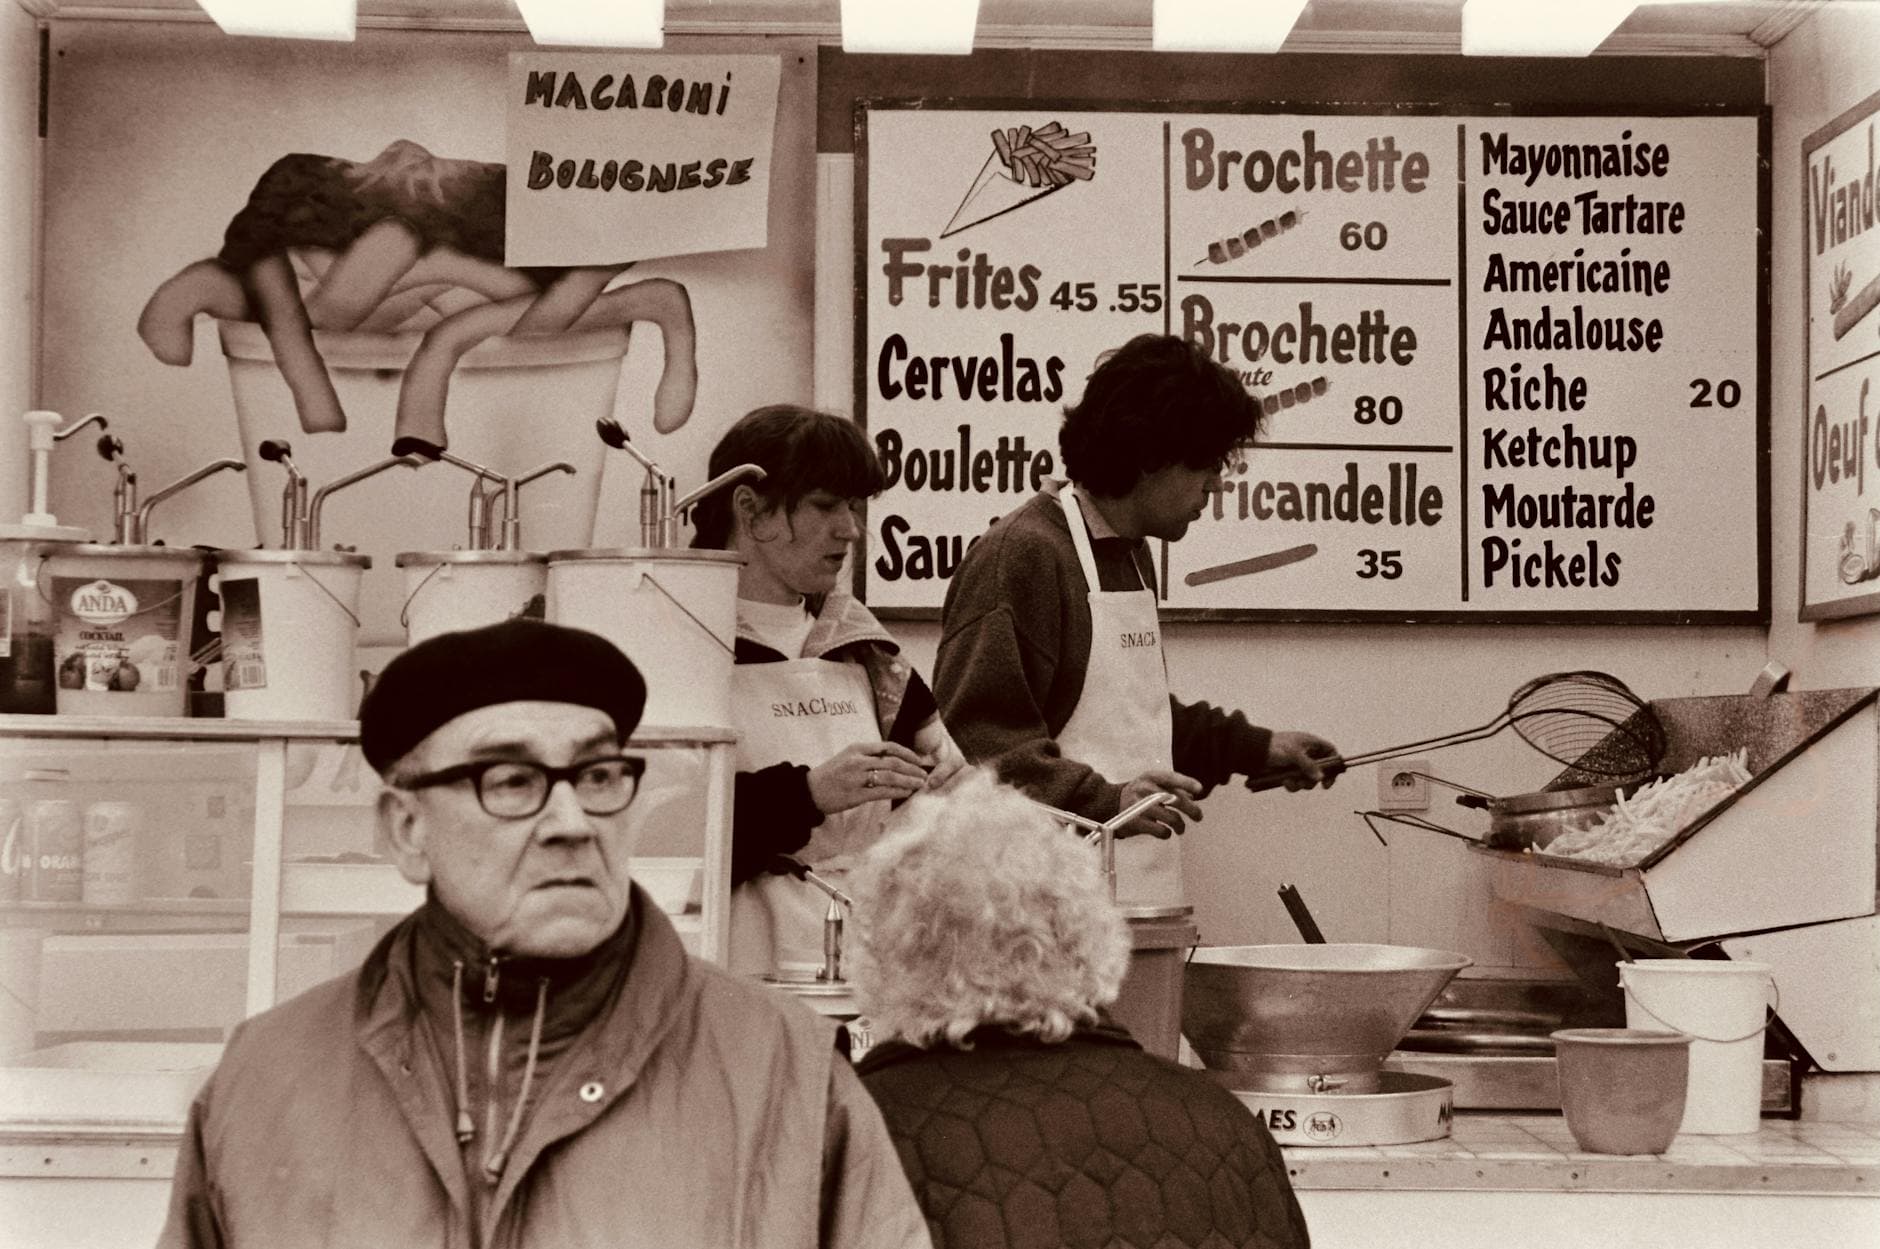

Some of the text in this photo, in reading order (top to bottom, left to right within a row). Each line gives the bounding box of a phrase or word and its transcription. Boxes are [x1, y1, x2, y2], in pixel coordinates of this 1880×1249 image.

[527, 150, 754, 193] BOLOGNESE
[1181, 127, 1430, 194] Brochette
[1480, 130, 1669, 187] Mayonnaise
[1339, 221, 1388, 251] 60
[1483, 188, 1686, 235] Sauce Tartare
[881, 237, 1042, 312] Frites
[1049, 281, 1099, 312] 45
[1483, 247, 1670, 296] Americaine
[1181, 294, 1418, 366] Brochette
[1483, 305, 1664, 352] Andalouse
[878, 333, 1066, 402] Cervelas
[1483, 362, 1742, 412] Riche 20
[1353, 395, 1403, 426] 80
[876, 424, 1053, 493] Boulette
[1482, 423, 1638, 479] Ketchup
[1813, 377, 1869, 497] Oeuf
[1212, 462, 1444, 527] ricandelle
[1482, 482, 1655, 529] Moutarde
[1355, 549, 1404, 580] 35
[1481, 535, 1622, 588] Pickels
[78, 595, 128, 613] ANDA
